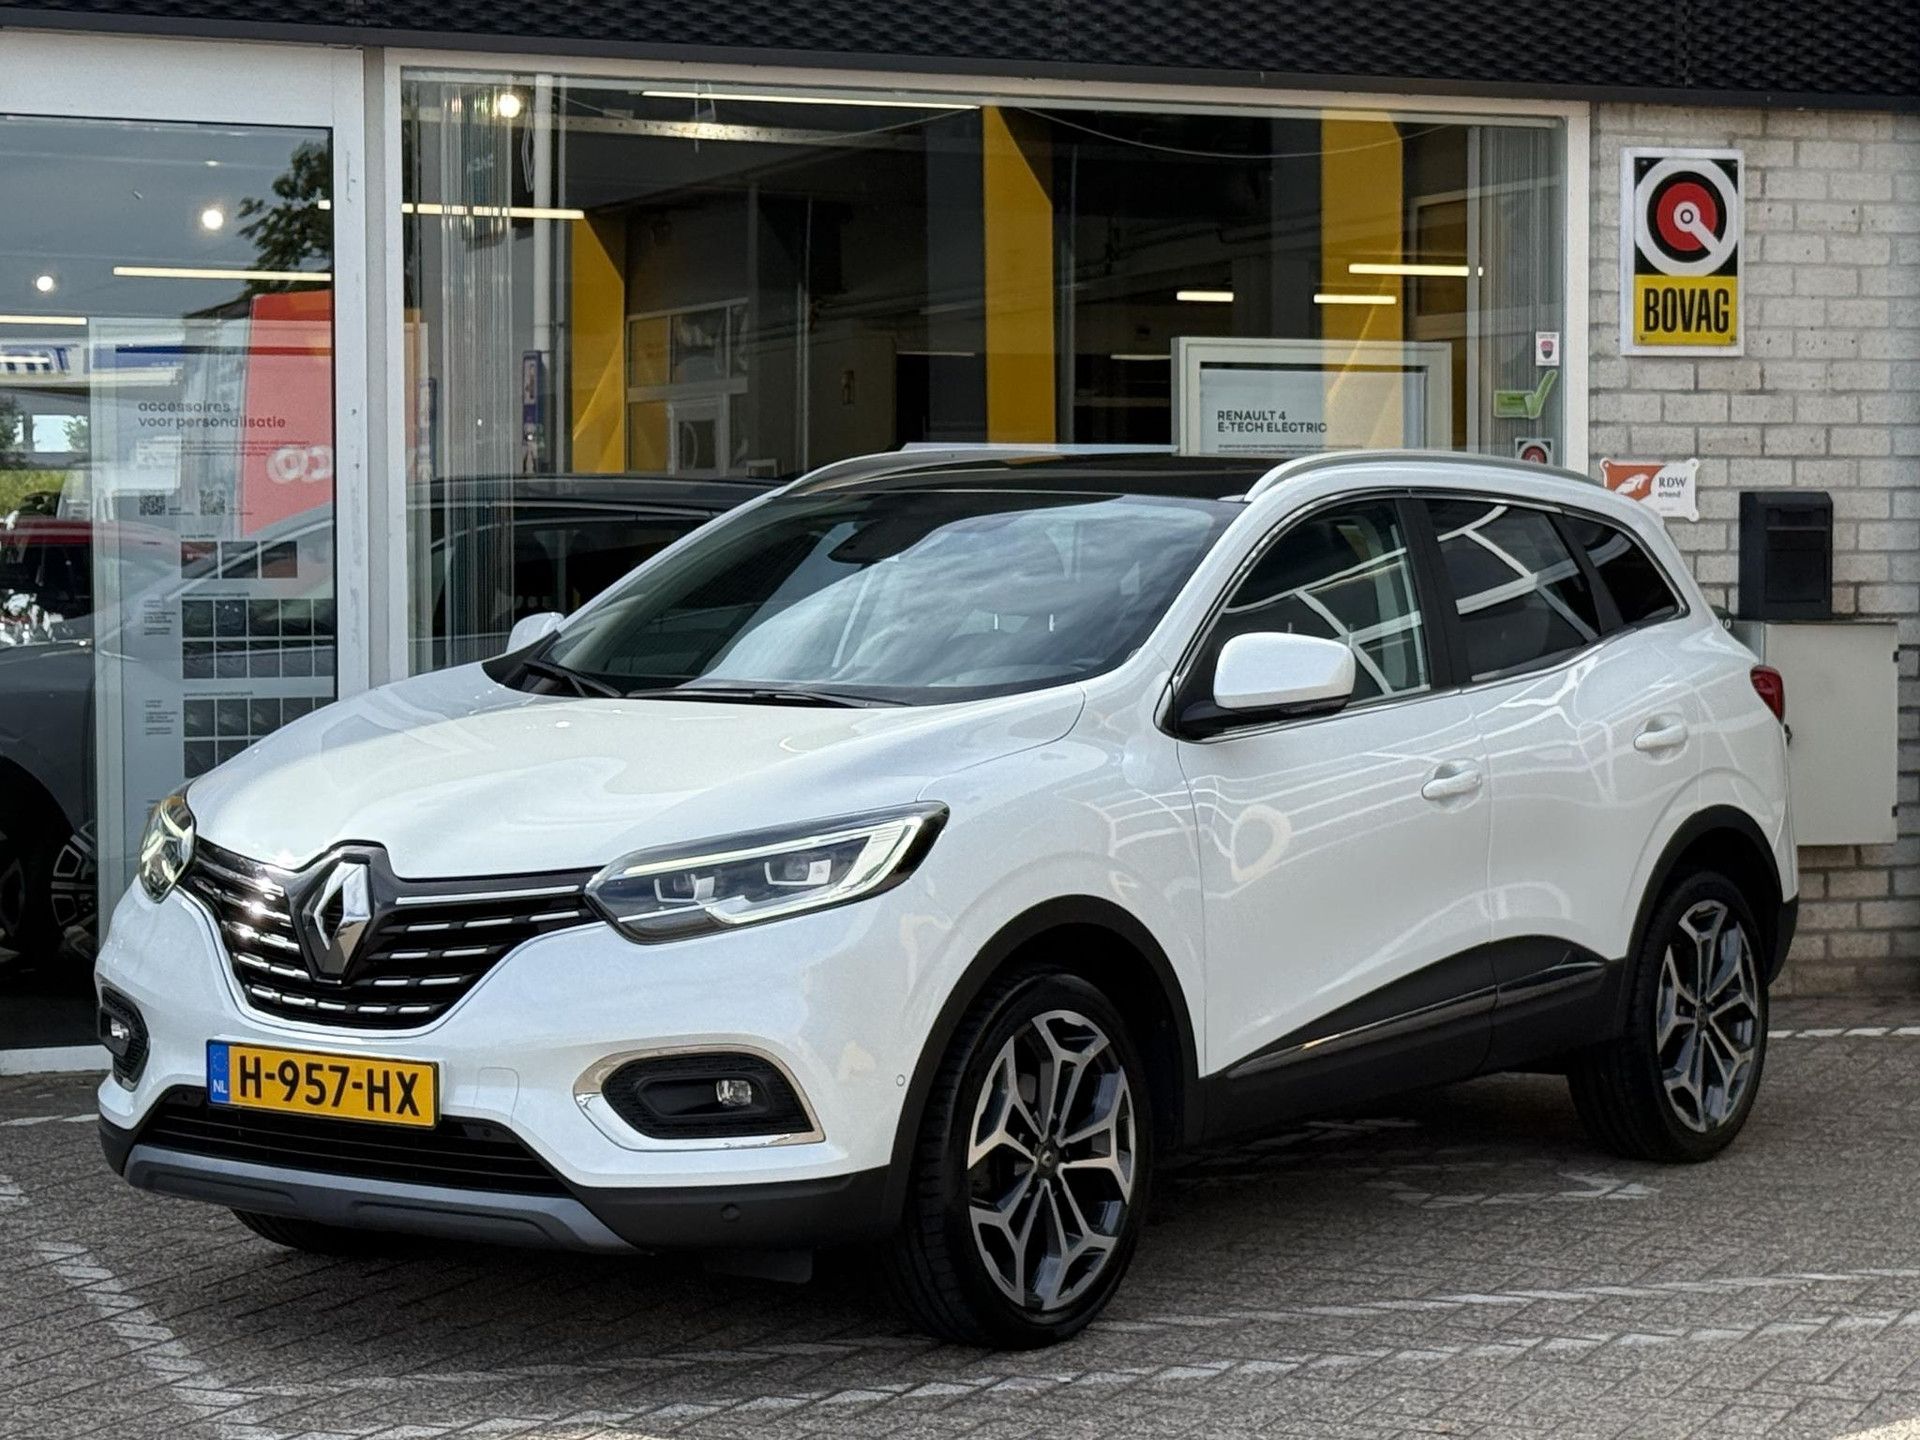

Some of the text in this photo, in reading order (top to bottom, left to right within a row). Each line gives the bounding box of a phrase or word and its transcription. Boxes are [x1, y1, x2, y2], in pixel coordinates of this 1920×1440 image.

[1643, 286, 1730, 334] BOVAG
[138, 400, 231, 412] accessoires
[1217, 410, 1287, 421] RENAULT 4
[138, 415, 286, 430] voor personalisatie
[1217, 422, 1327, 433] E-TECH ELECTRIC
[1658, 476, 1687, 488] RDW
[212, 1078, 228, 1094] NL
[239, 1055, 420, 1117] H-957-HX
